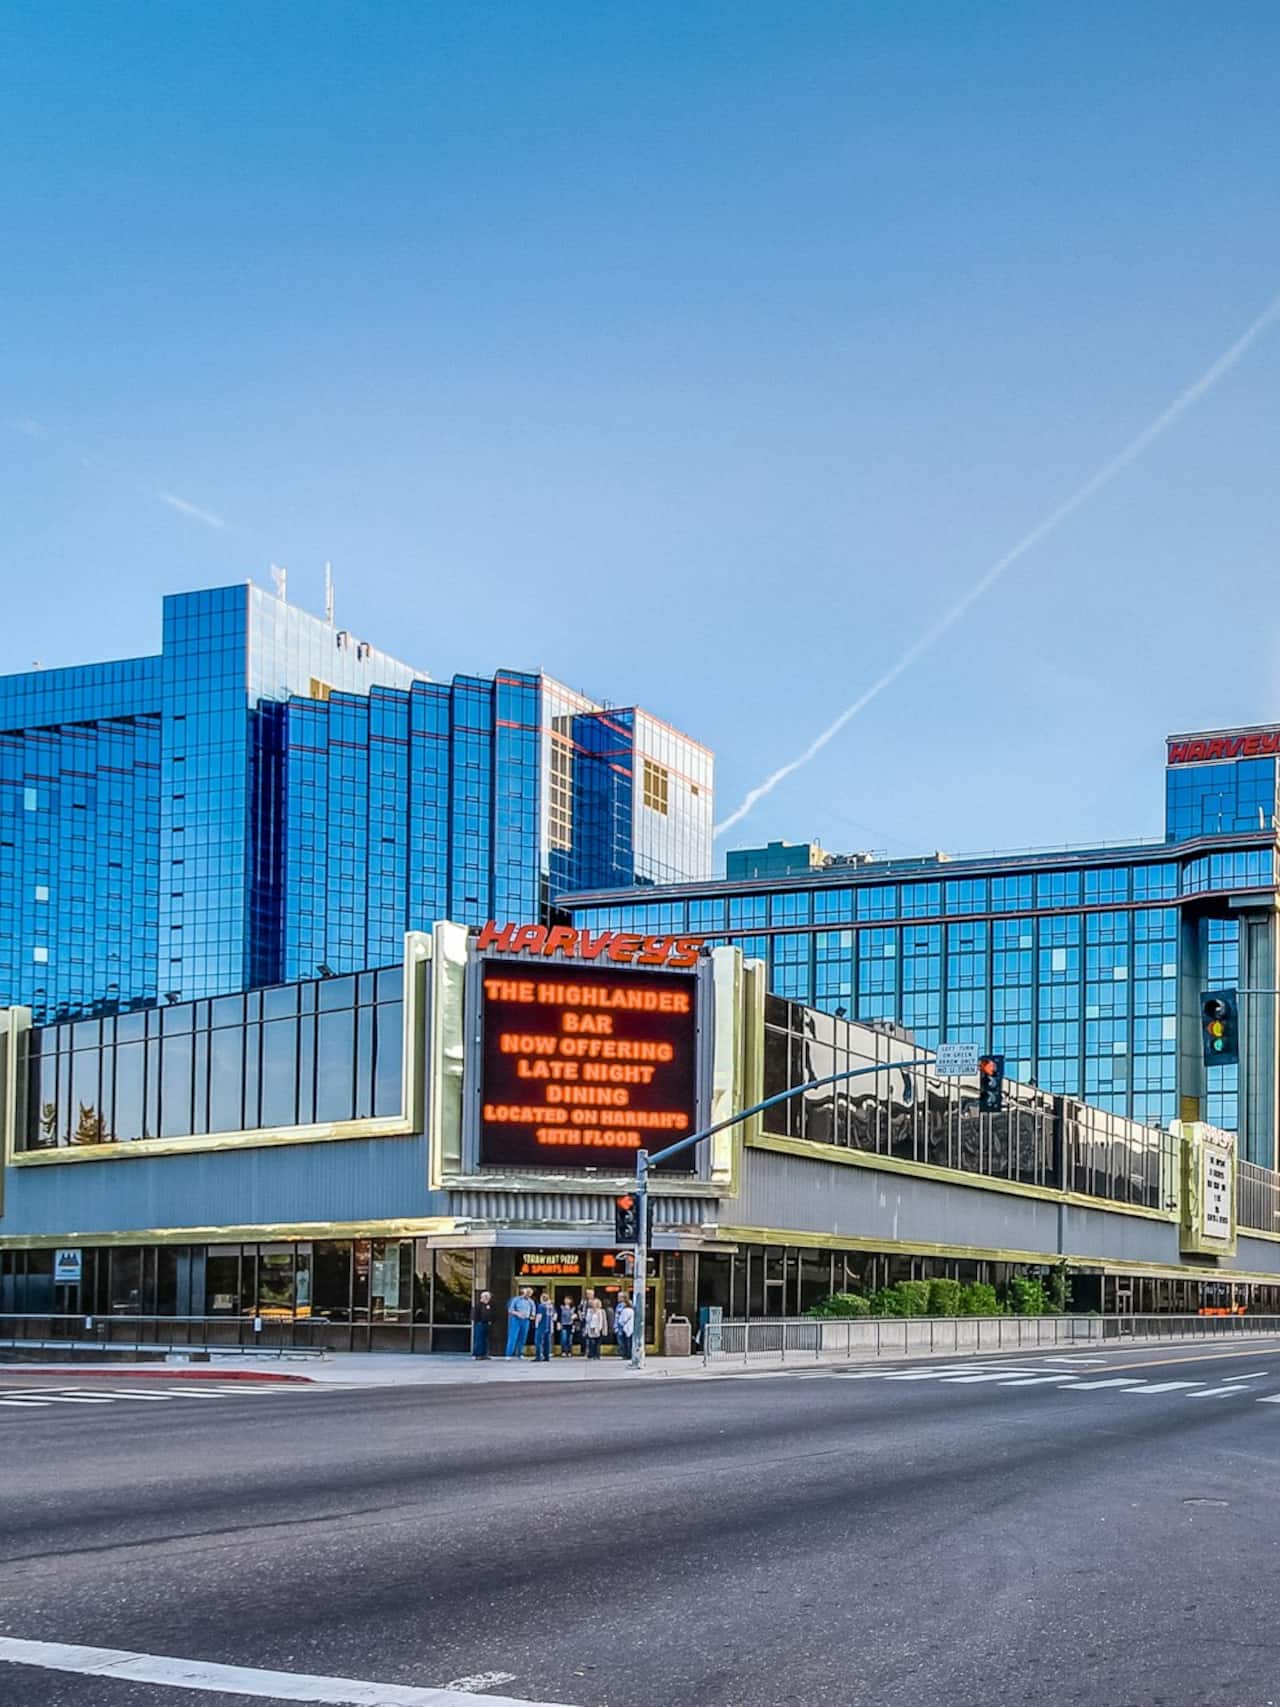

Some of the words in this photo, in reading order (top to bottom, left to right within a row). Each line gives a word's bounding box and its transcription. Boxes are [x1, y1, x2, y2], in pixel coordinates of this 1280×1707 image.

[476, 919, 704, 967] HARVEYS
[484, 979, 535, 1003] THE
[537, 983, 690, 1013] HIGHLANDER
[562, 1012, 613, 1034] BAR
[500, 1034, 557, 1054] NOW
[559, 1037, 674, 1062] OFFERING
[517, 1059, 579, 1080] LATE
[582, 1062, 655, 1084] NIGHT
[545, 1084, 629, 1106] DINING
[484, 1104, 568, 1124] LOCATED
[570, 1109, 598, 1125] ON
[600, 1110, 689, 1130] HARRAH'S
[582, 1129, 641, 1147] FLOOR
